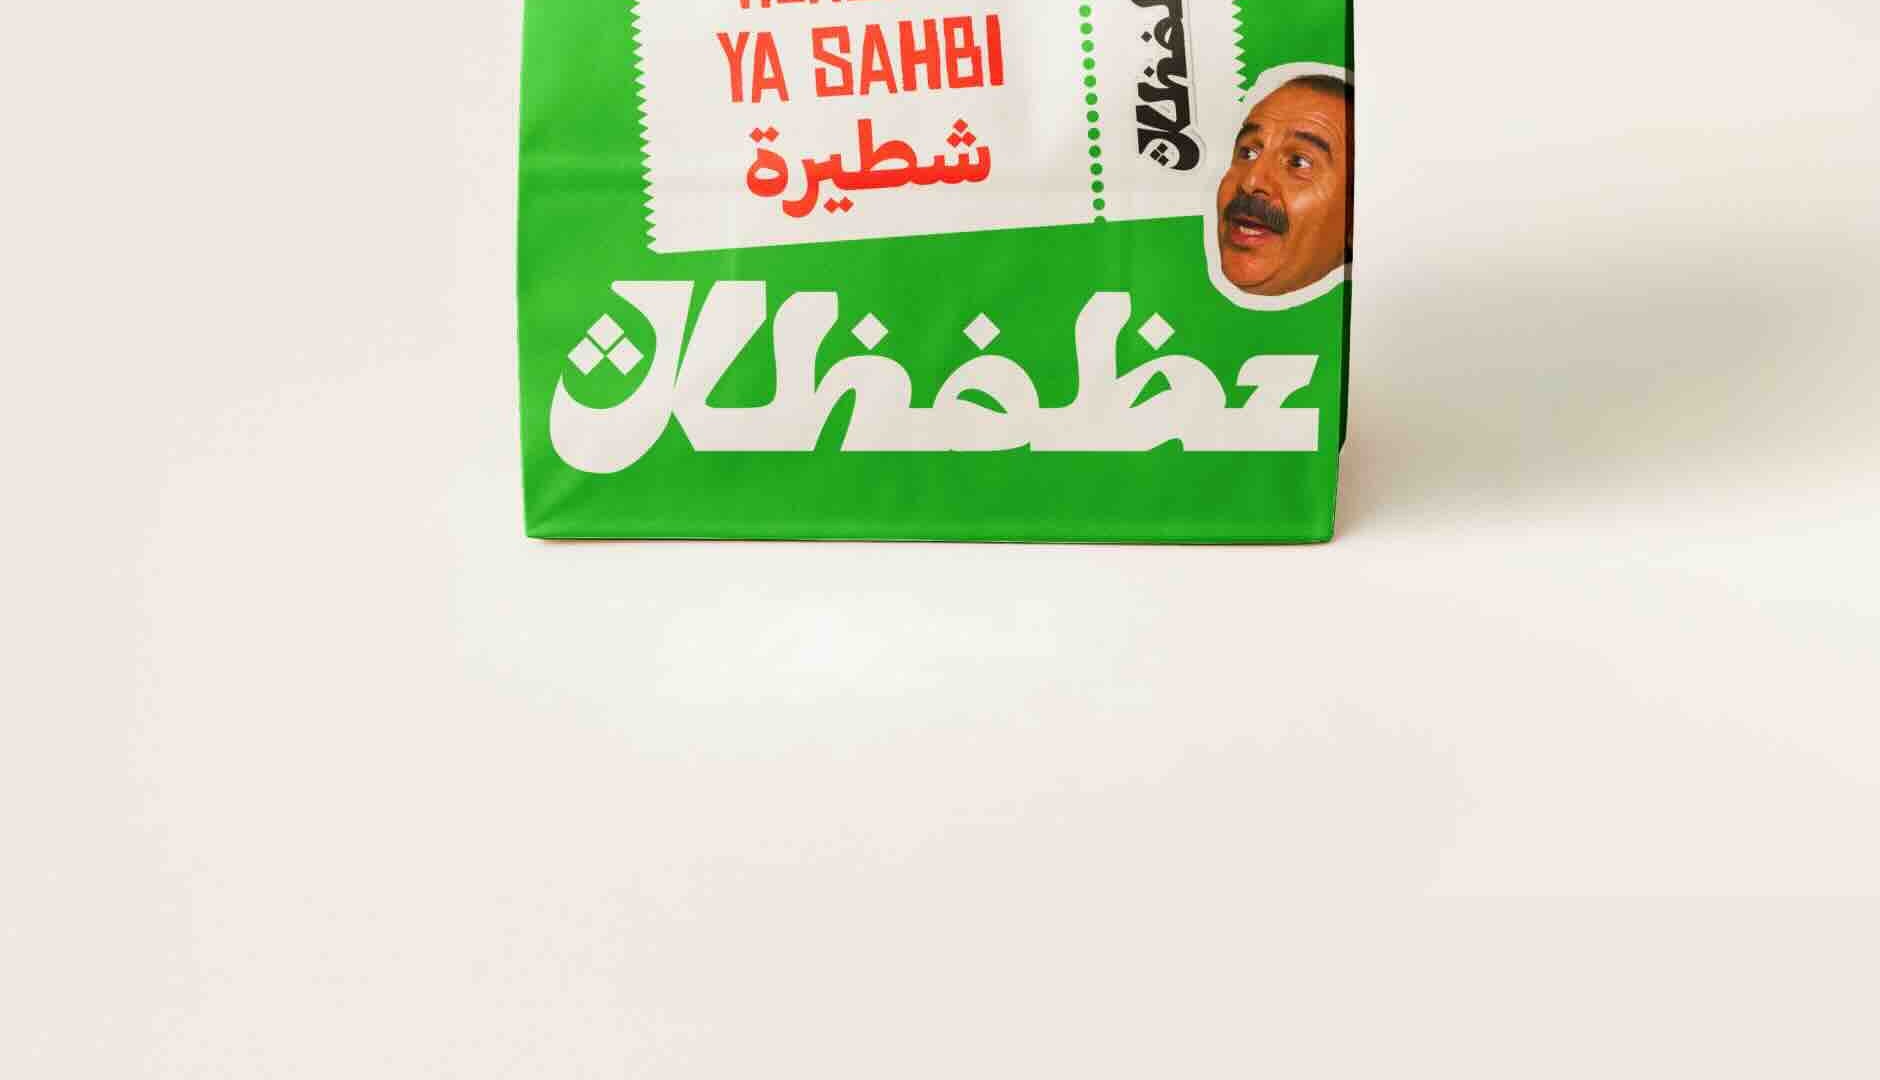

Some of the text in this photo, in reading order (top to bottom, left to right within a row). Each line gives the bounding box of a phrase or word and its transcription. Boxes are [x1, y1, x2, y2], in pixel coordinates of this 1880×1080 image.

[716, 14, 1004, 103] YA SAHBI
[745, 118, 991, 218] شطيرة
[549, 279, 1320, 474] Khobz
